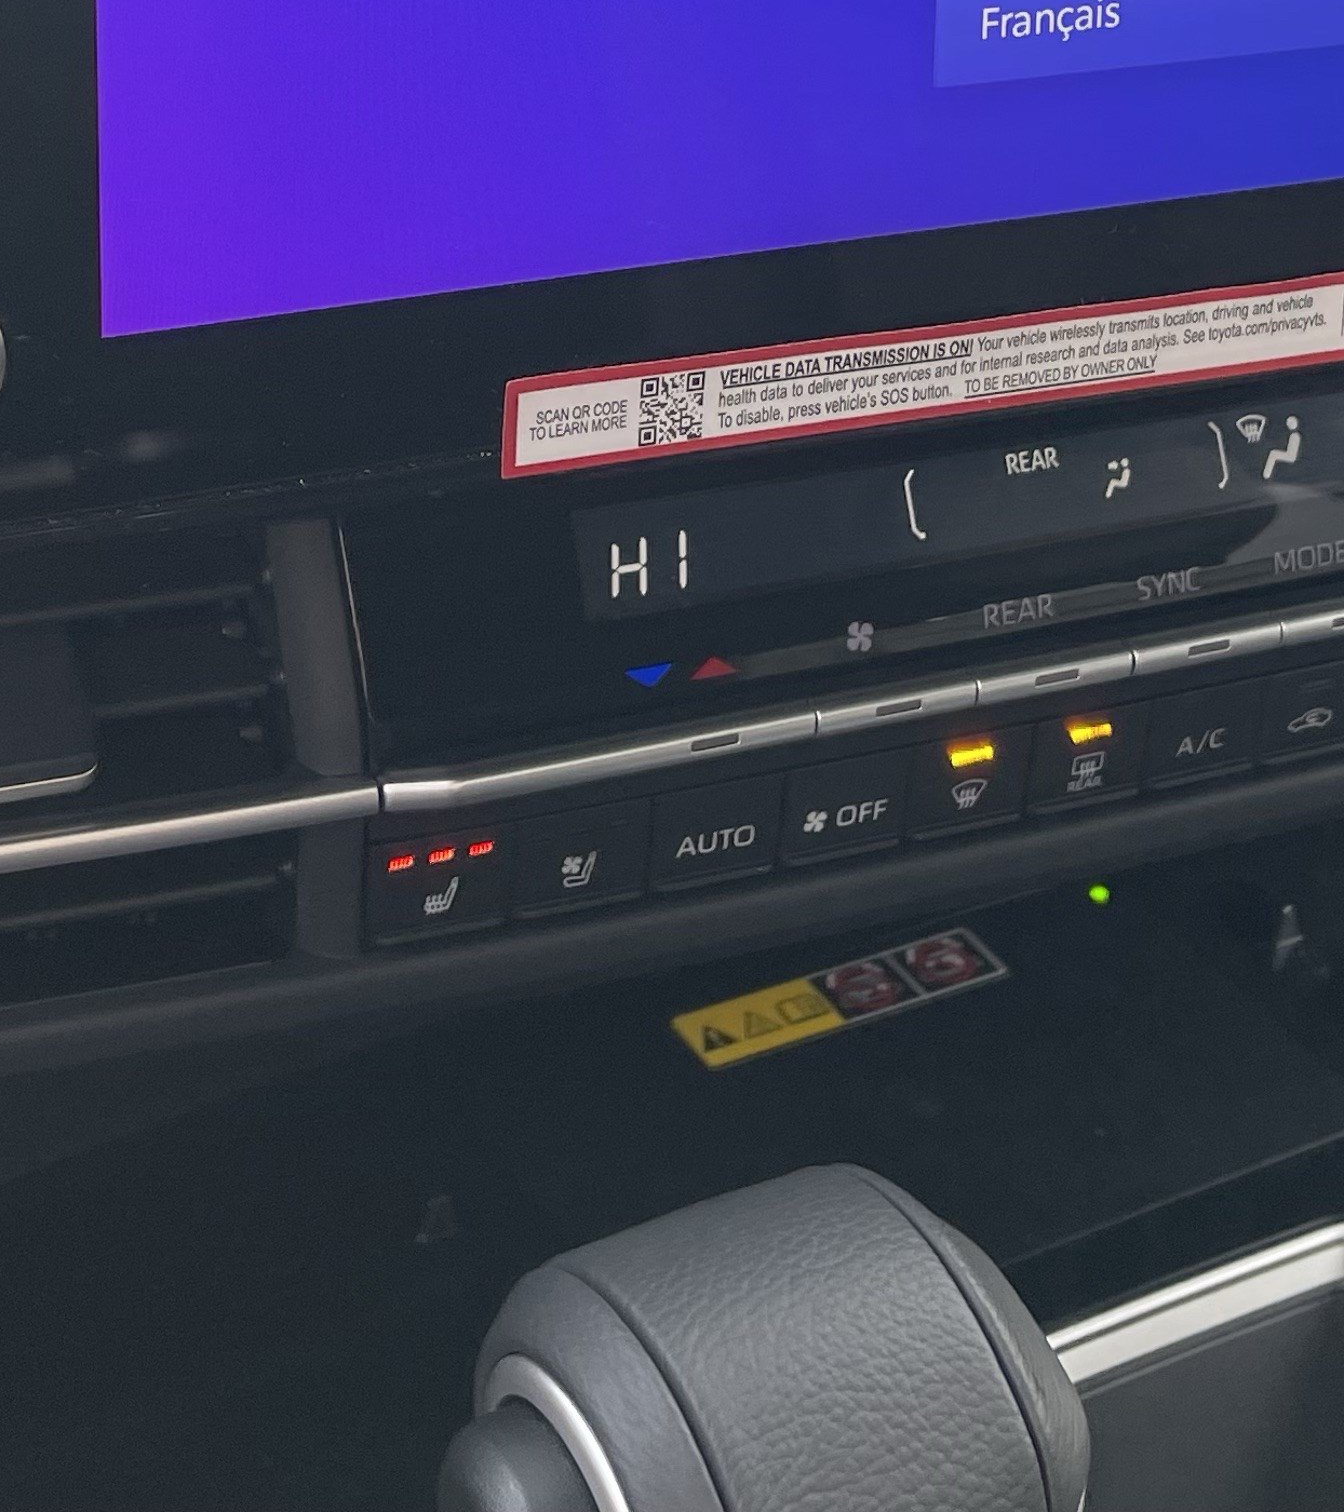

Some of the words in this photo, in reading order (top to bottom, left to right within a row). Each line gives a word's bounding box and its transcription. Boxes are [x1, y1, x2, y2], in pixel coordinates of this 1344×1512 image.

[720, 363, 781, 386] VEHICLE
[785, 358, 821, 378] DATA
[825, 345, 930, 372] TRANSMISSION
[934, 343, 946, 358] IS
[949, 338, 974, 356] ON!
[978, 336, 1004, 352] Your
[1007, 328, 1047, 349] vehicle
[1050, 321, 1106, 342] wirelessly
[1109, 314, 1160, 335] transmits
[1163, 308, 1209, 326] location,
[1212, 301, 1249, 320] driving
[1252, 299, 1274, 315] and
[1277, 294, 1314, 313] vehicle
[718, 388, 756, 408] health
[760, 385, 788, 402] data
[792, 383, 804, 397] to
[807, 376, 848, 395] deliver
[851, 373, 879, 393] your
[882, 366, 931, 383] services
[935, 362, 957, 378] and
[961, 360, 978, 375] for
[979, 352, 1023, 372] internal
[1025, 346, 1076, 365] research
[1079, 341, 1101, 358] and
[1103, 338, 1128, 355] data
[1131, 332, 1179, 352] analysis.
[1183, 328, 1206, 344] See
[965, 378, 981, 394] TO
[984, 376, 1000, 392] BE
[1003, 367, 1061, 389] REMOVED
[1063, 364, 1080, 381] BY
[1081, 358, 1126, 378] OWNER
[1127, 355, 1158, 371] ONLY
[536, 407, 569, 425] SCAN
[593, 399, 628, 417] CODE
[718, 412, 733, 429] To
[736, 405, 784, 427] disable,
[788, 402, 822, 422] press
[825, 392, 877, 414] vehicle's
[880, 387, 910, 406] SOS
[912, 384, 953, 402] button.
[529, 426, 546, 442] TO
[549, 420, 589, 439] LEARN
[591, 415, 628, 433] MORE
[1004, 446, 1060, 475] REAR
[610, 529, 688, 598] HI
[1136, 566, 1202, 601] SYNC
[983, 593, 1054, 629] REAR
[1174, 728, 1226, 758] A/C
[835, 798, 889, 828] OFF
[676, 824, 756, 858] AUTO
